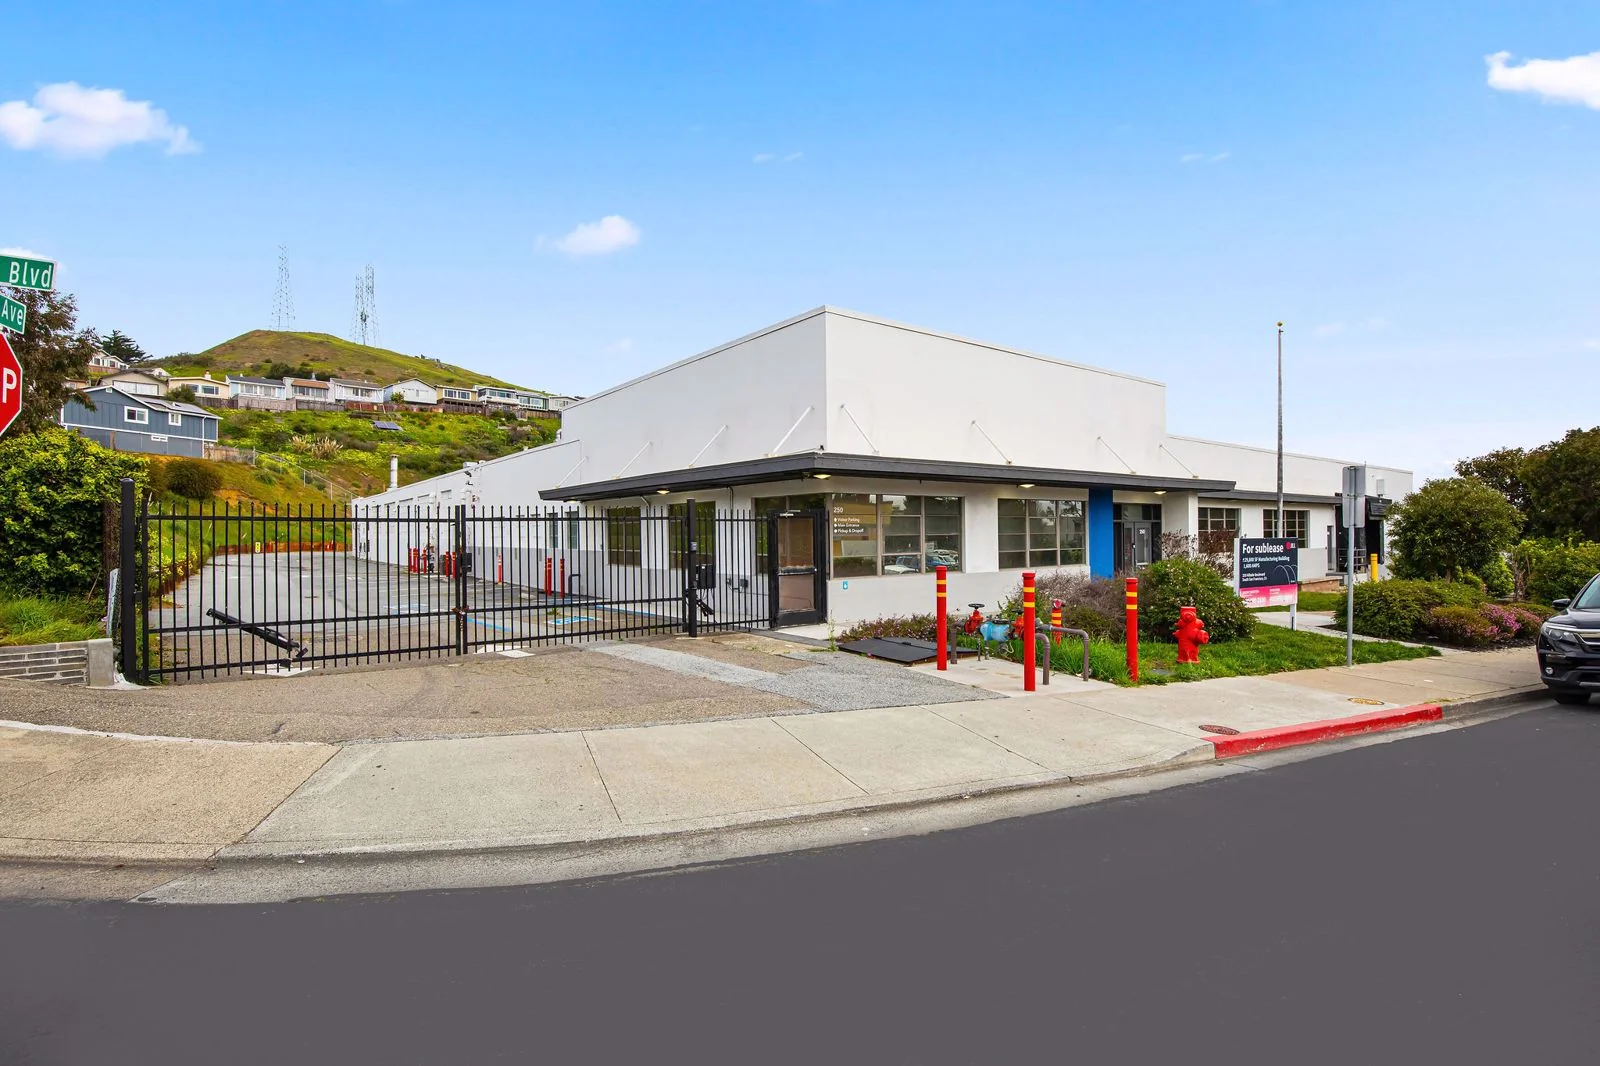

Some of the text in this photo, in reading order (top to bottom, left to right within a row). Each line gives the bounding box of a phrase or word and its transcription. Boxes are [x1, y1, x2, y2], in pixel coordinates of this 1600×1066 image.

[9, 261, 53, 288] Blvd
[1, 299, 24, 326] Ave
[1242, 542, 1284, 554] For sublease
